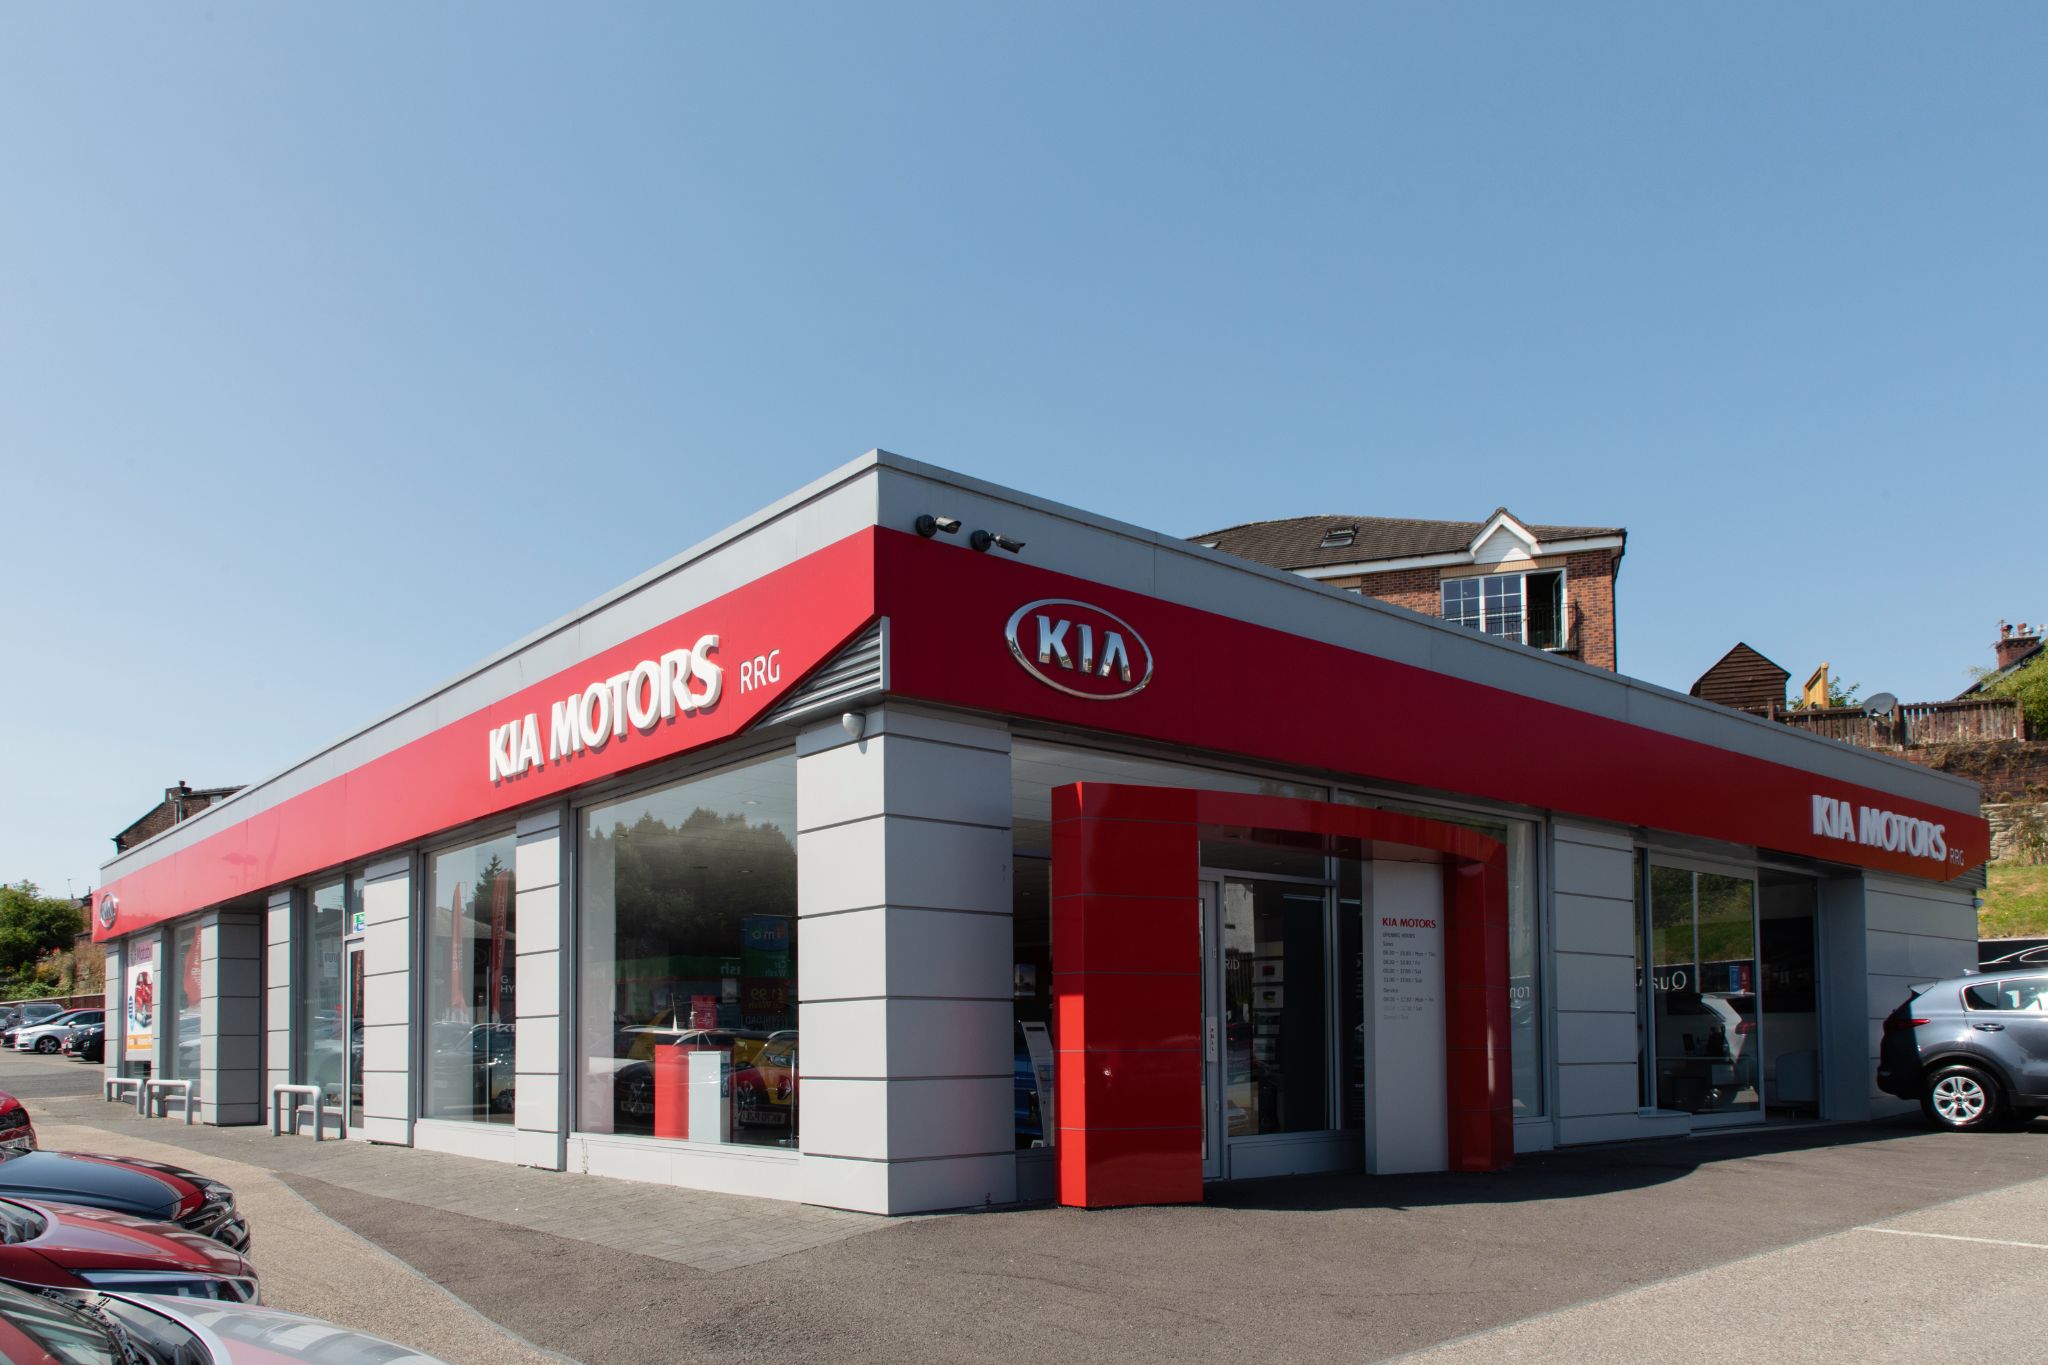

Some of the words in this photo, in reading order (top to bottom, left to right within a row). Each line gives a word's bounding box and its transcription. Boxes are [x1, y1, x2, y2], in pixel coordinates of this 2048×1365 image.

[1035, 615, 1132, 682] KIA
[489, 713, 544, 782] KIA
[550, 634, 724, 761] MOTORS
[740, 649, 780, 694] RRG
[1812, 794, 1856, 842] KIA
[1859, 806, 1947, 862] MOTORS
[1382, 917, 1397, 927] KIA
[1400, 918, 1437, 929] MOTORS
